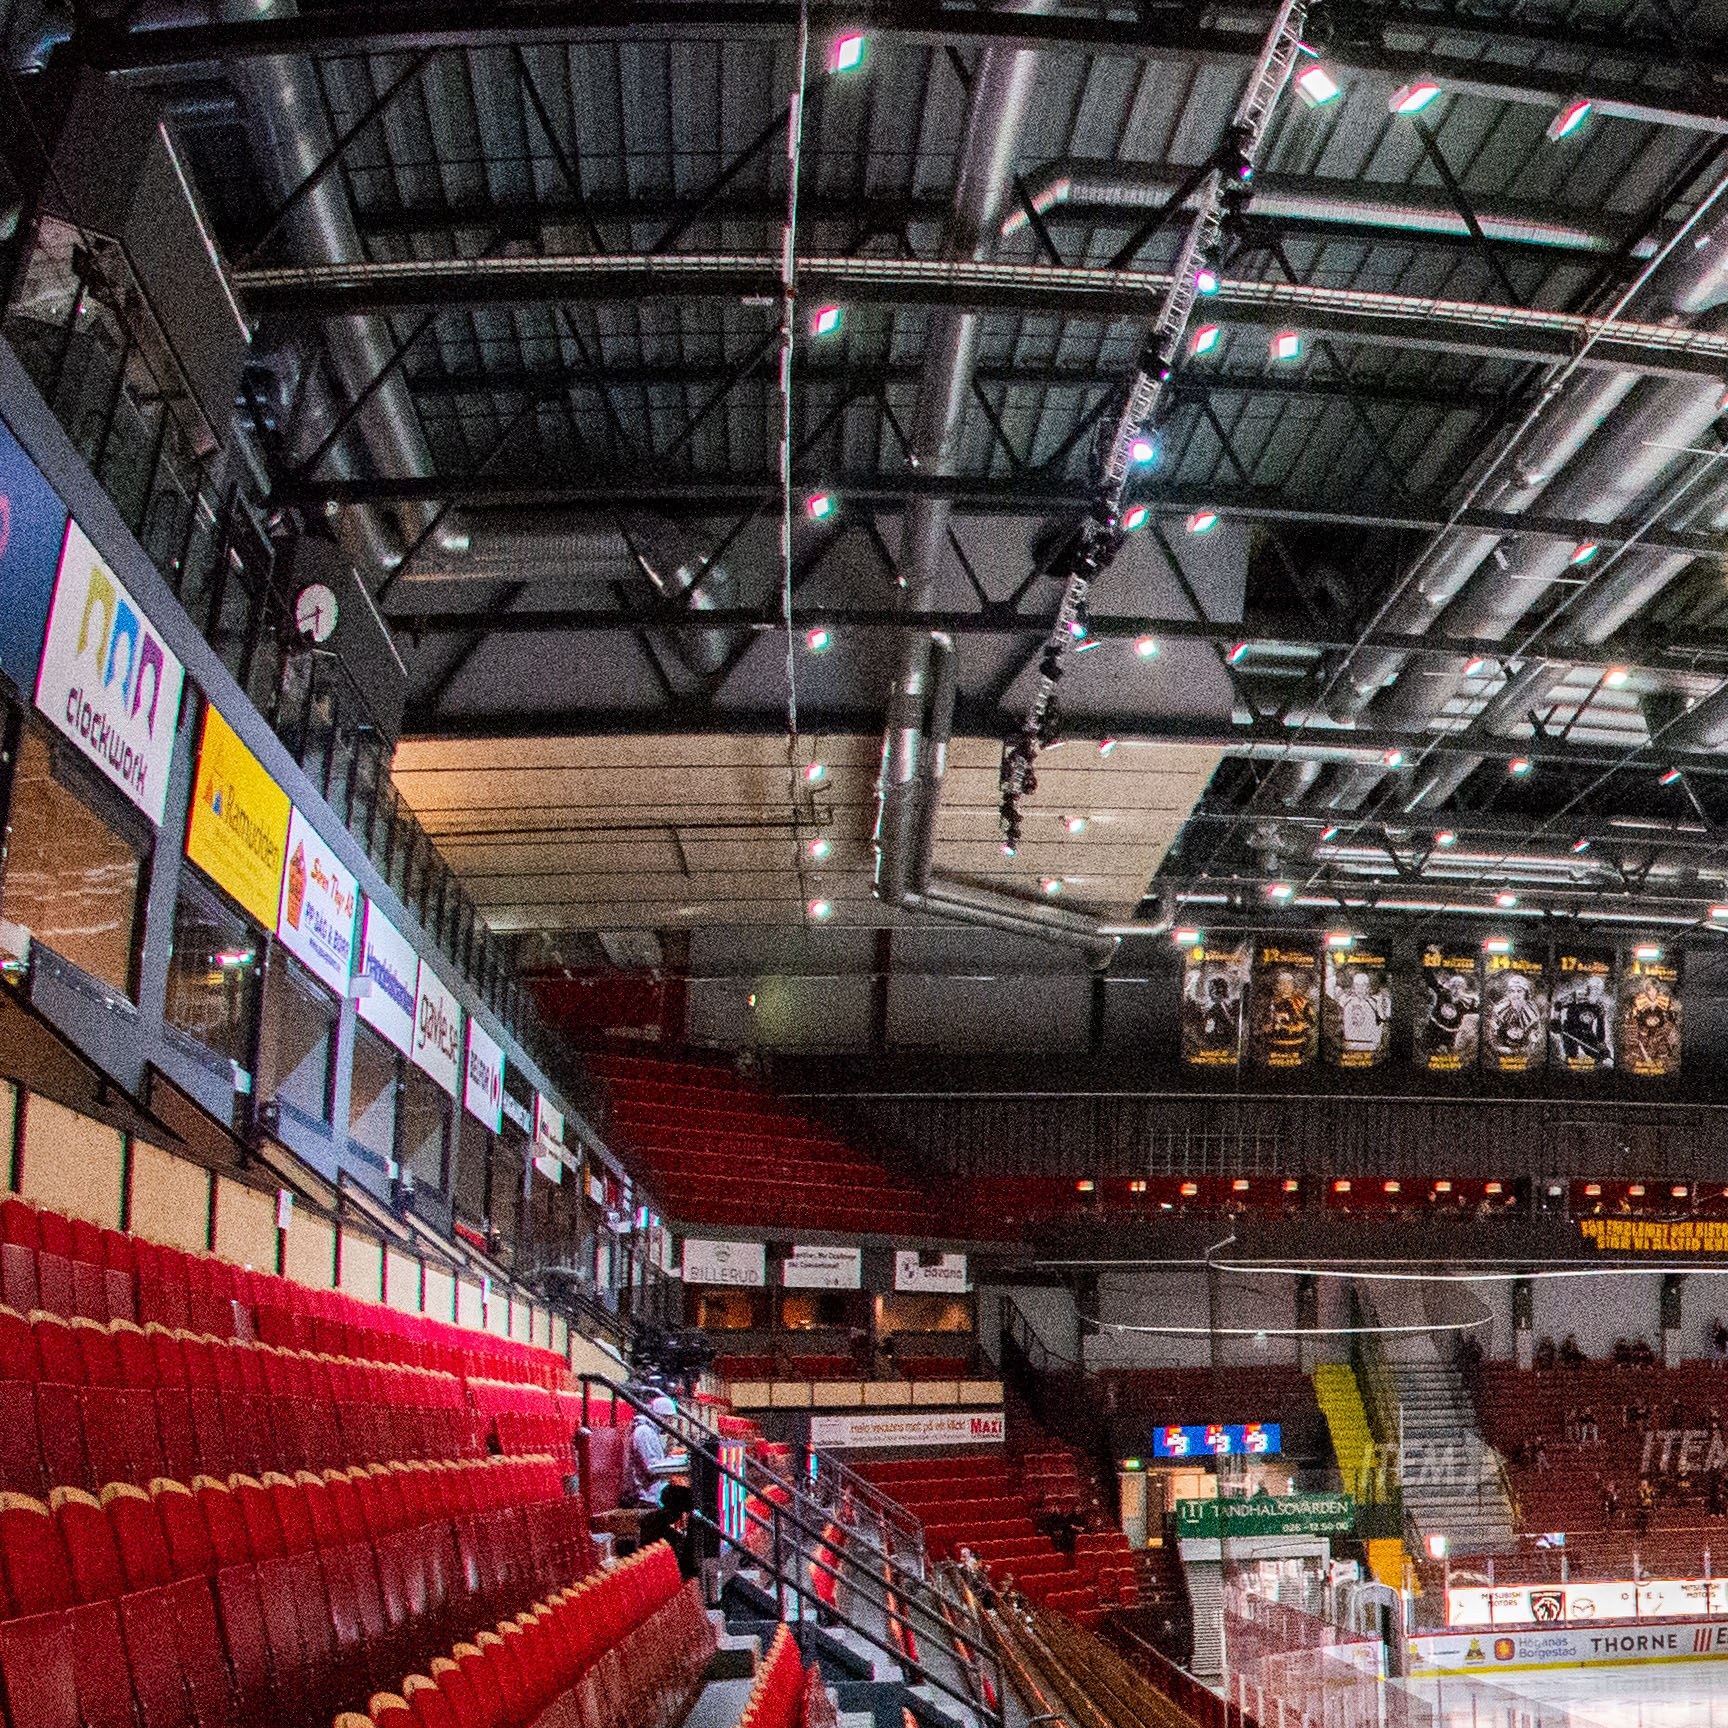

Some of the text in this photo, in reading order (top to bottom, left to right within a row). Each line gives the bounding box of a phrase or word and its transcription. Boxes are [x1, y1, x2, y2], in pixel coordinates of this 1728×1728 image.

[66, 687, 149, 797] clockwork
[226, 784, 280, 872] Ramudden
[418, 993, 458, 1066] gavle.se
[688, 1267, 760, 1285] BILLERUD
[970, 1417, 1003, 1437] MAXI
[1518, 1646, 1577, 1659] Borgestad
[1590, 1634, 1678, 1653] THORNE
